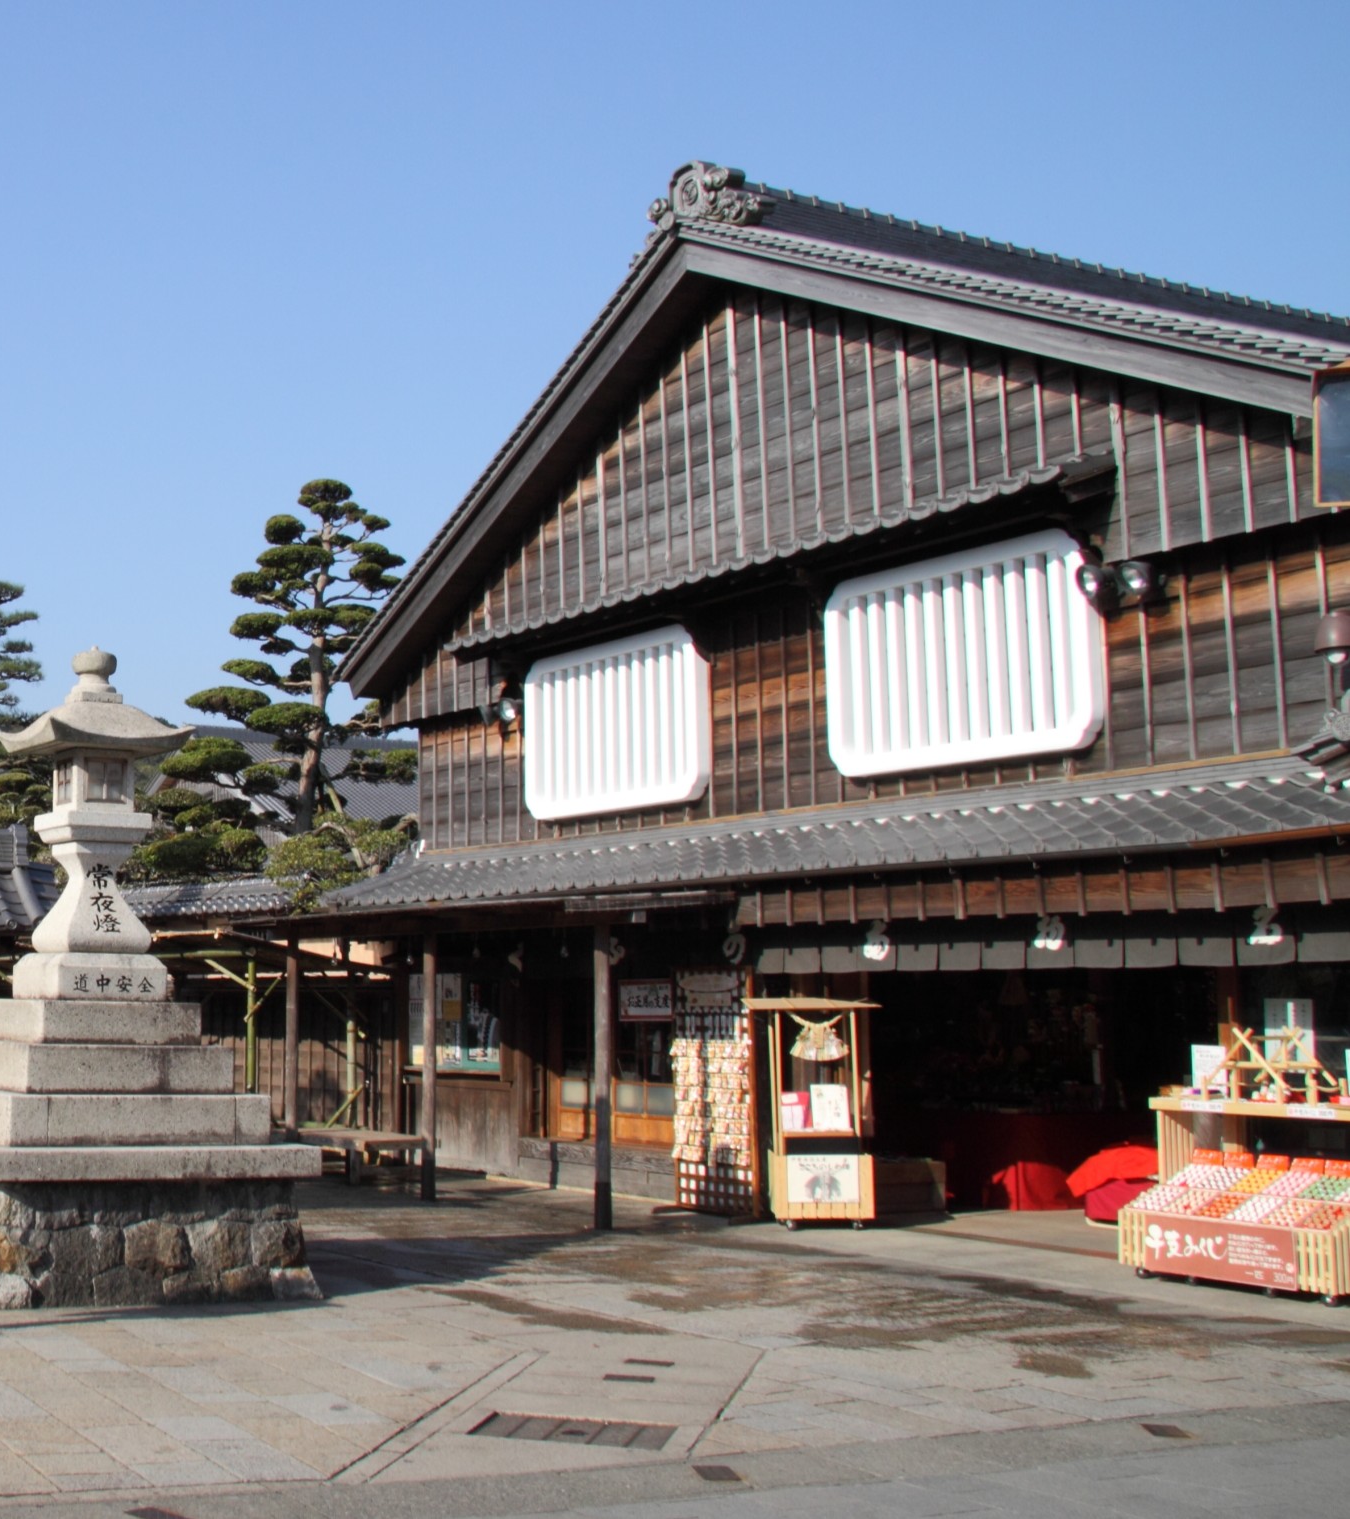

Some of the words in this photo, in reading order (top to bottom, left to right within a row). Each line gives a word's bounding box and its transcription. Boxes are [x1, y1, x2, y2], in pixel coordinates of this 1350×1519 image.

[86, 863, 121, 934] 常夜燈
[73, 973, 155, 993] 道中安全
